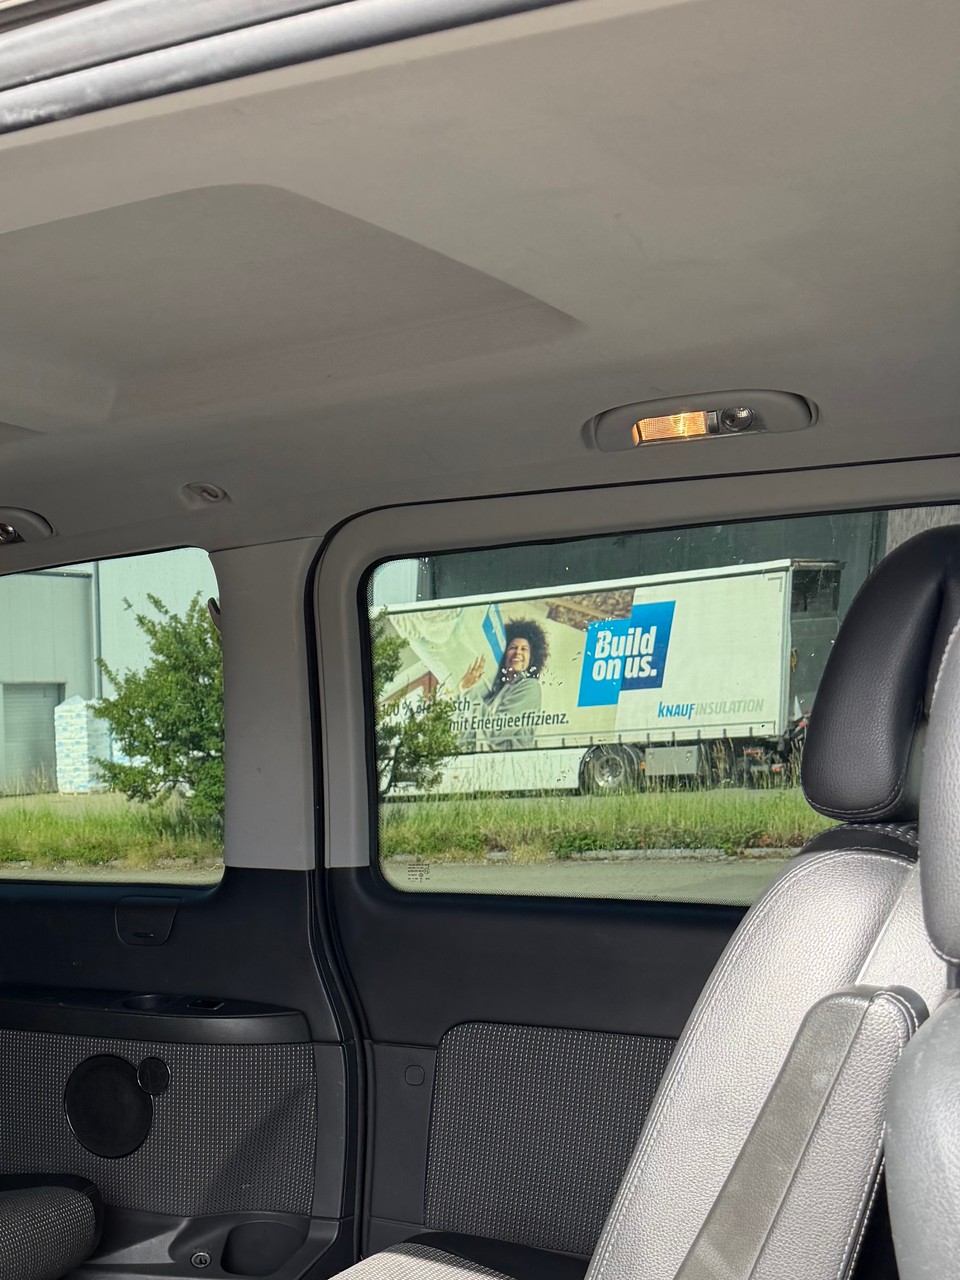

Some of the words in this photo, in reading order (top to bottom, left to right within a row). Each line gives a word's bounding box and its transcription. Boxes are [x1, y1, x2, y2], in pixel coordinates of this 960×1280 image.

[594, 626, 657, 658] Build
[592, 658, 622, 681] on
[624, 656, 657, 678] us.
[657, 701, 696, 720] KNAUF
[695, 699, 764, 716] INSULATION
[449, 716, 469, 731] mit
[470, 711, 569, 732] Energieeffizienz.
